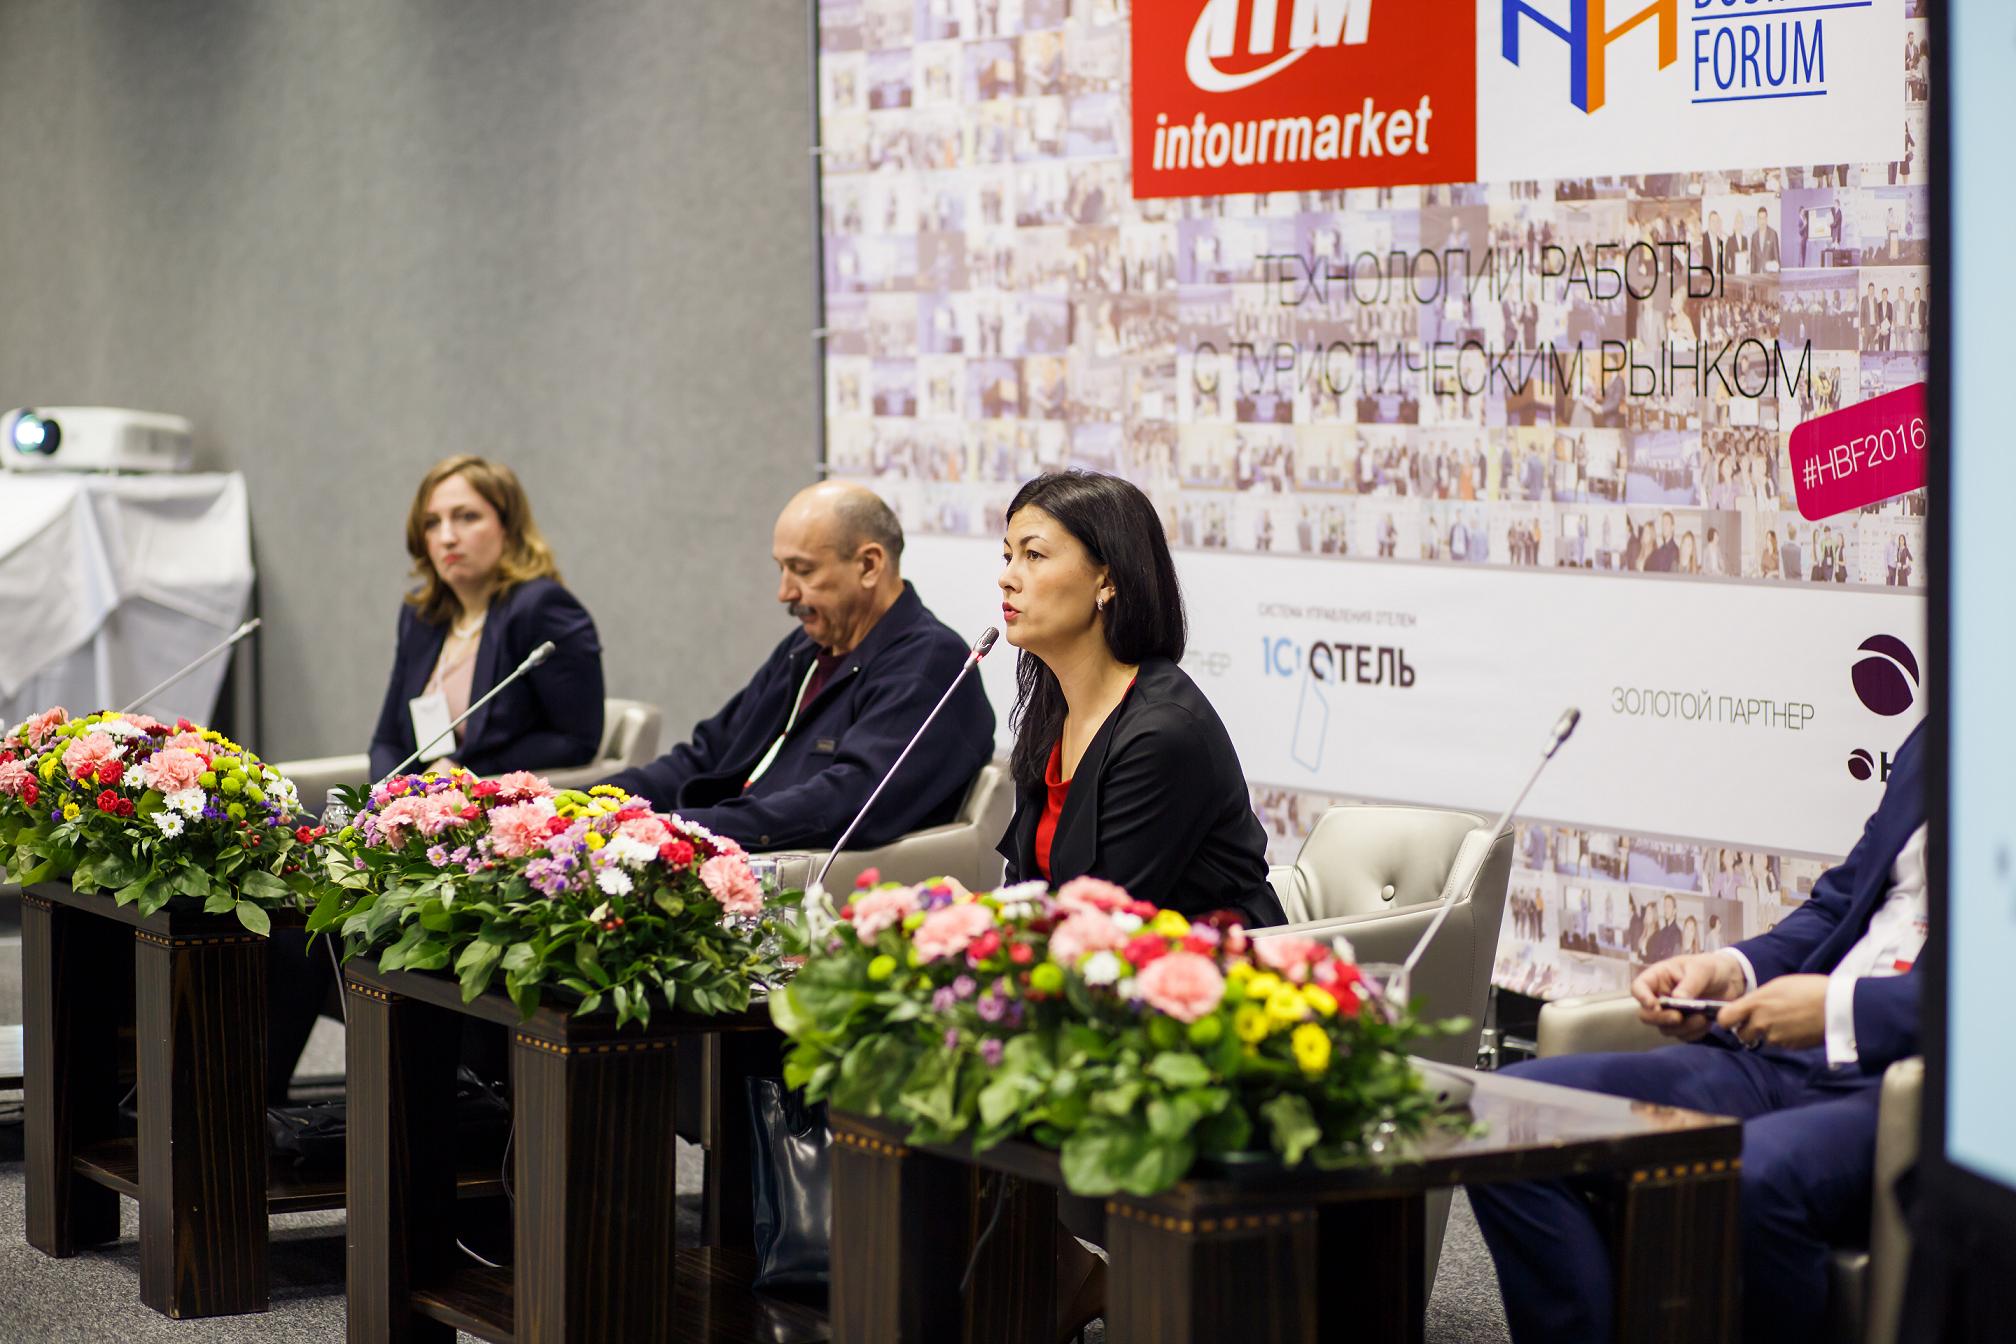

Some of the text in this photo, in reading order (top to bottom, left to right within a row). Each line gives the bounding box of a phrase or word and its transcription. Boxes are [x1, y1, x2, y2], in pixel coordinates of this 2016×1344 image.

[1694, 18, 1825, 91] FORUM
[1152, 94, 1432, 170] intourmarket
[1255, 240, 1725, 306] ТЕХНОЛОГИИ РАБОТЫ
[1193, 337, 1813, 399] С ТУРИСТИЧЕСКИМ РЫНКОМ
[1802, 417, 1927, 491] #HBF2016
[1610, 686, 1815, 731] ЗОЛОТОЙ ПАРТНЕР
